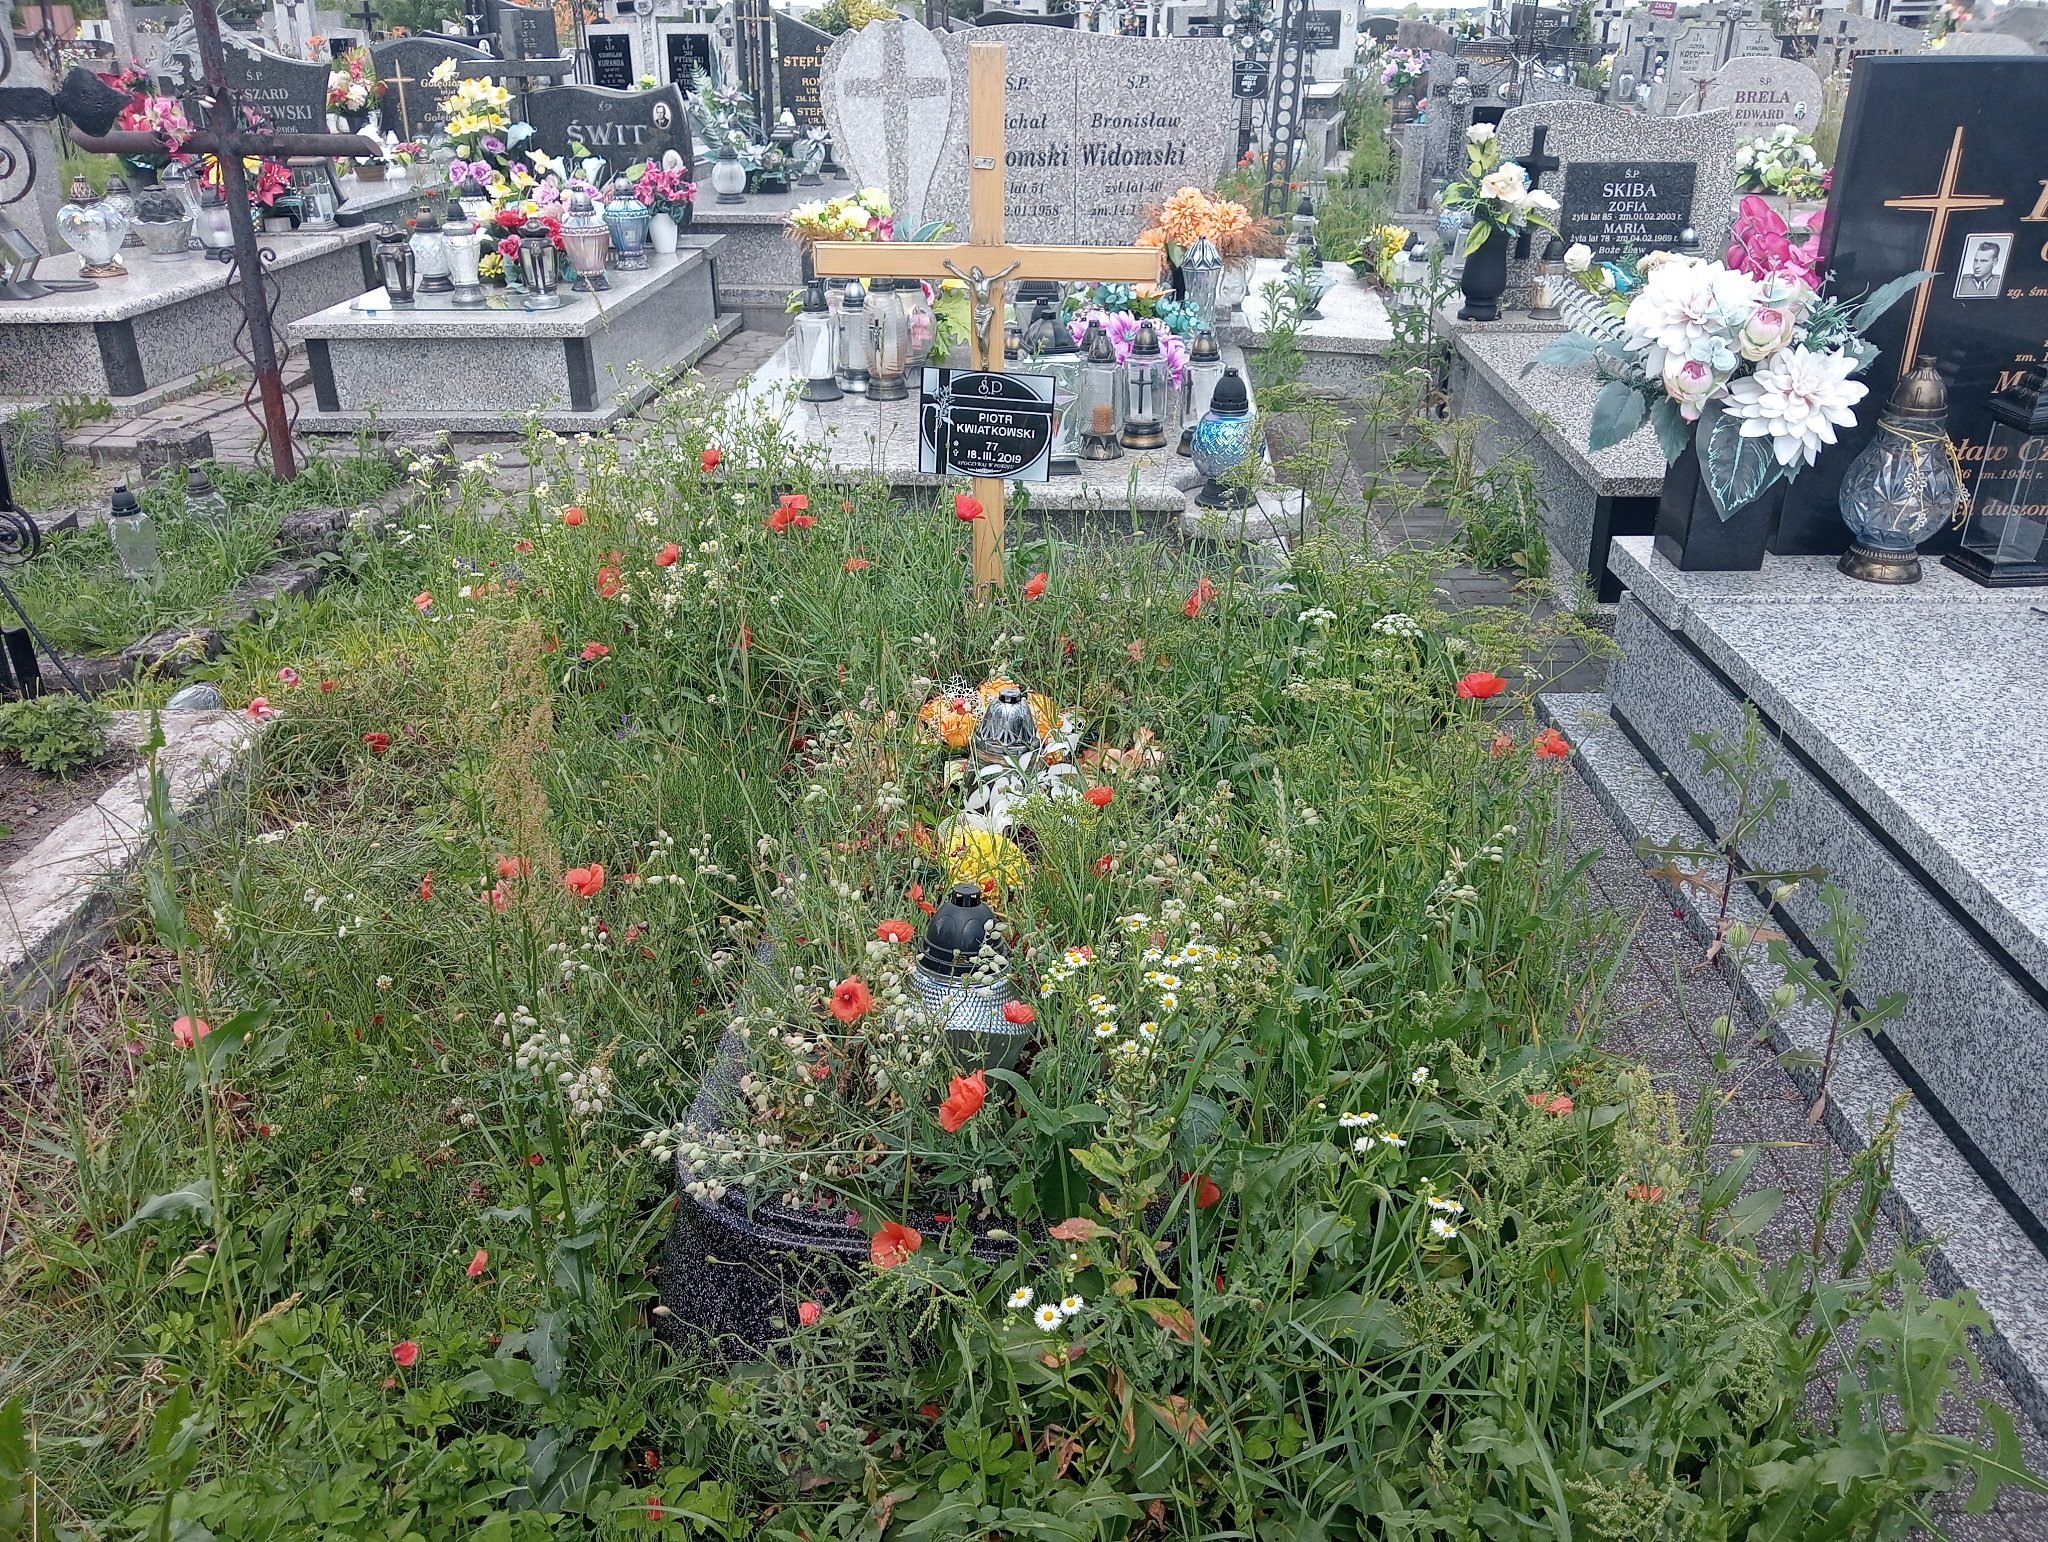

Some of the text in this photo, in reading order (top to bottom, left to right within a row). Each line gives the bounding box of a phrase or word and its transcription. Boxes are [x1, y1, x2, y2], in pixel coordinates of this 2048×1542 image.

[1734, 90, 1790, 104] BRELA
[1005, 112, 1048, 129] ichał
[1090, 111, 1182, 129] Bronisław
[1734, 109, 1785, 120] EDWARD
[566, 119, 648, 146] ŚWIT
[1082, 142, 1187, 167] Widomski
[1602, 182, 1658, 198] SKIBA
[1607, 200, 1648, 212] ZOFIA
[1571, 212, 1589, 223] żyła
[1602, 213, 1613, 221] 85
[1603, 222, 1647, 234] MARIA
[1569, 234, 1587, 243] żyła
[1600, 234, 1611, 243] 78
[2014, 353, 2036, 362] zm.
[978, 412, 1013, 425] PIOTR
[956, 423, 1035, 439] KWIATKOWSKI
[985, 441, 999, 452] 77
[966, 449, 1022, 464] 18.III.2019
